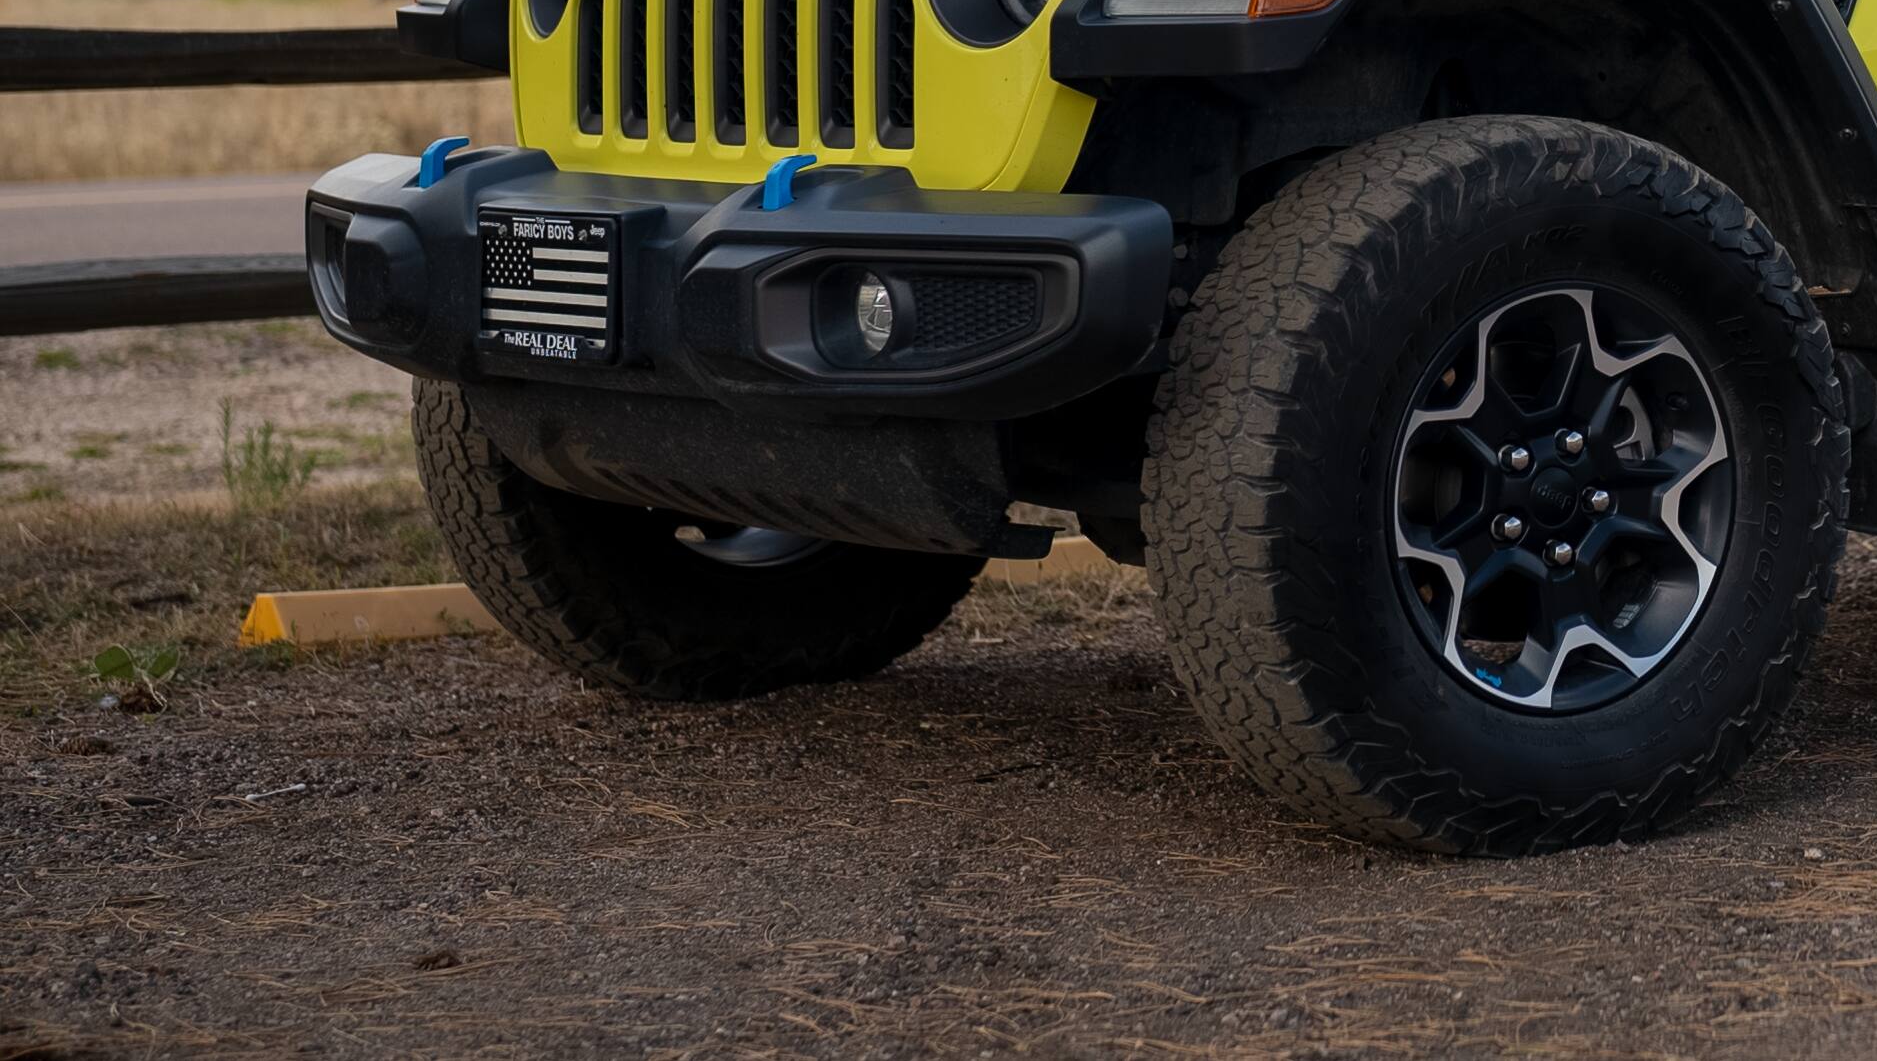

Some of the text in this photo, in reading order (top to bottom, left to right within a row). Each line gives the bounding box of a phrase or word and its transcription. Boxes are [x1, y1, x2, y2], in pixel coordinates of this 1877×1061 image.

[513, 222, 575, 241] FARICY BOYS
[590, 224, 605, 238] Jeep
[504, 331, 577, 351] The REAL DEAL
